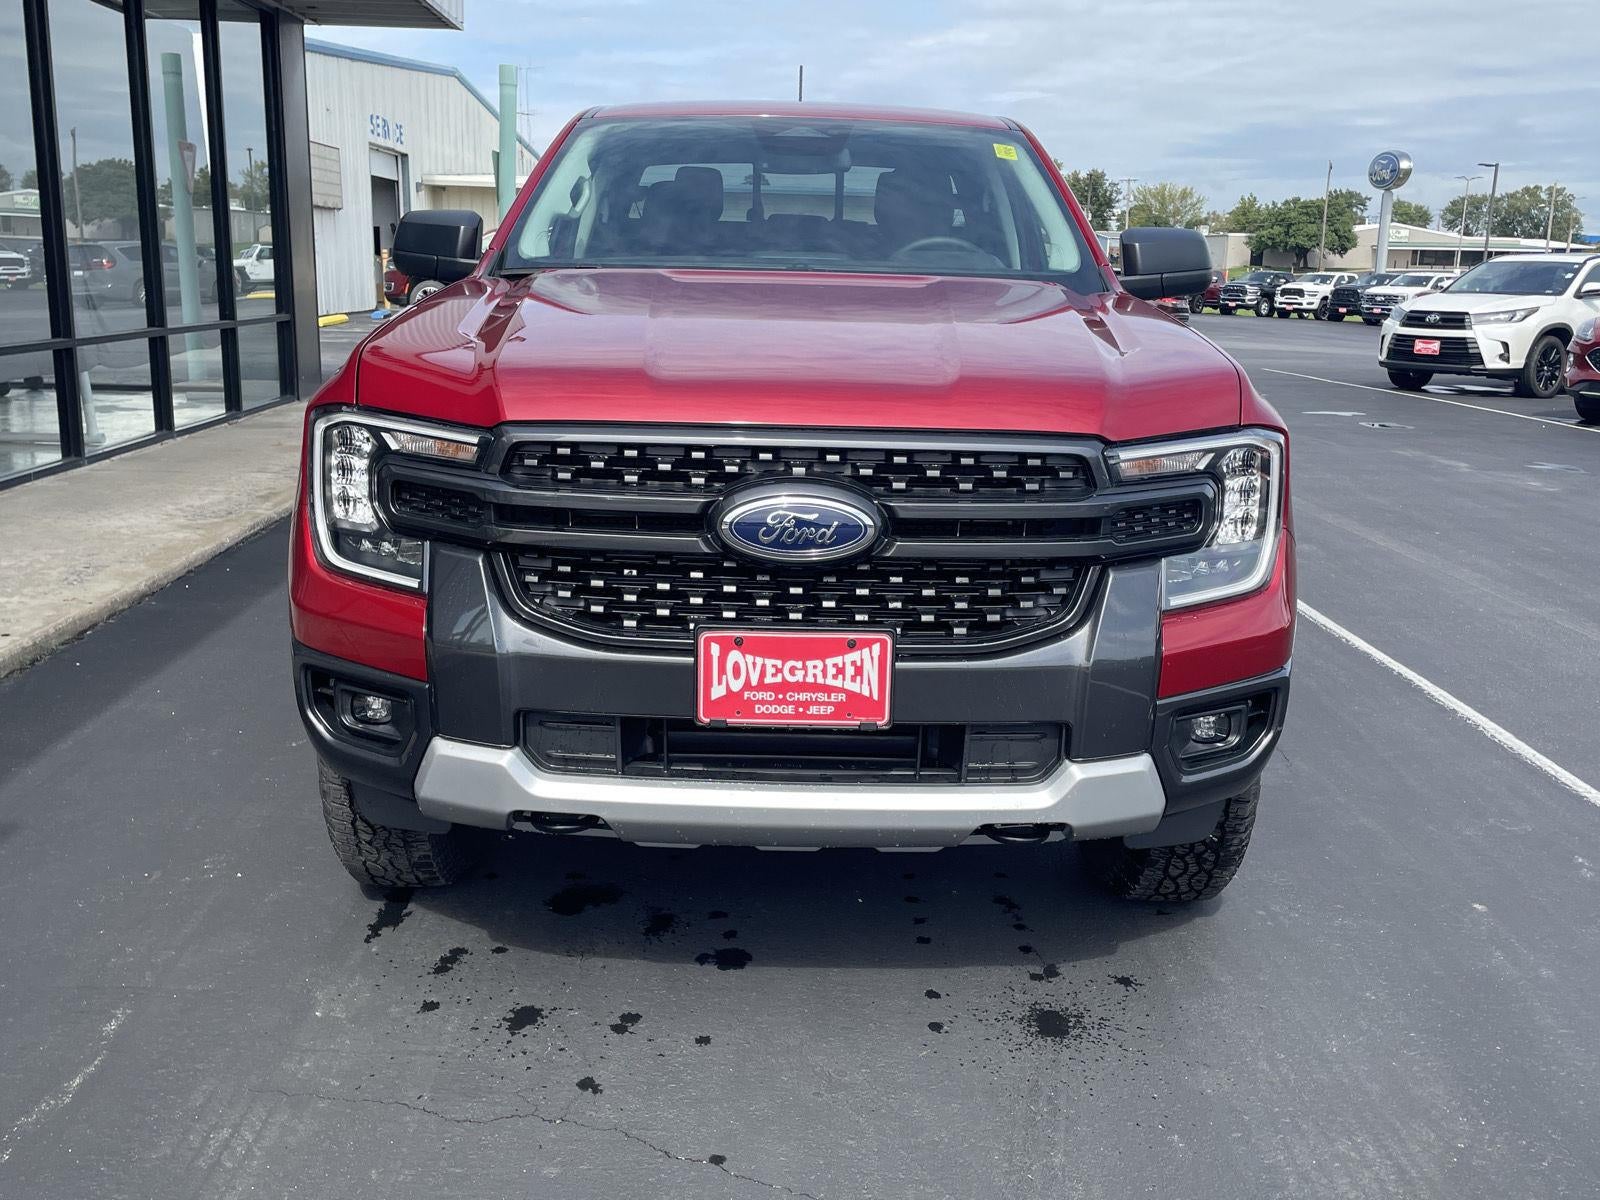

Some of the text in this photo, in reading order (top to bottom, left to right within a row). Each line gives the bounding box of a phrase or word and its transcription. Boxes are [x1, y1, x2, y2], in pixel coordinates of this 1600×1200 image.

[369, 113, 404, 145] SERVCE
[1370, 159, 1393, 181] Ford
[758, 510, 838, 545] Ford
[710, 641, 881, 701] LOVEGREEN
[743, 691, 846, 702] FORD CHRYSLER
[755, 705, 835, 715] DODGE JEEP
